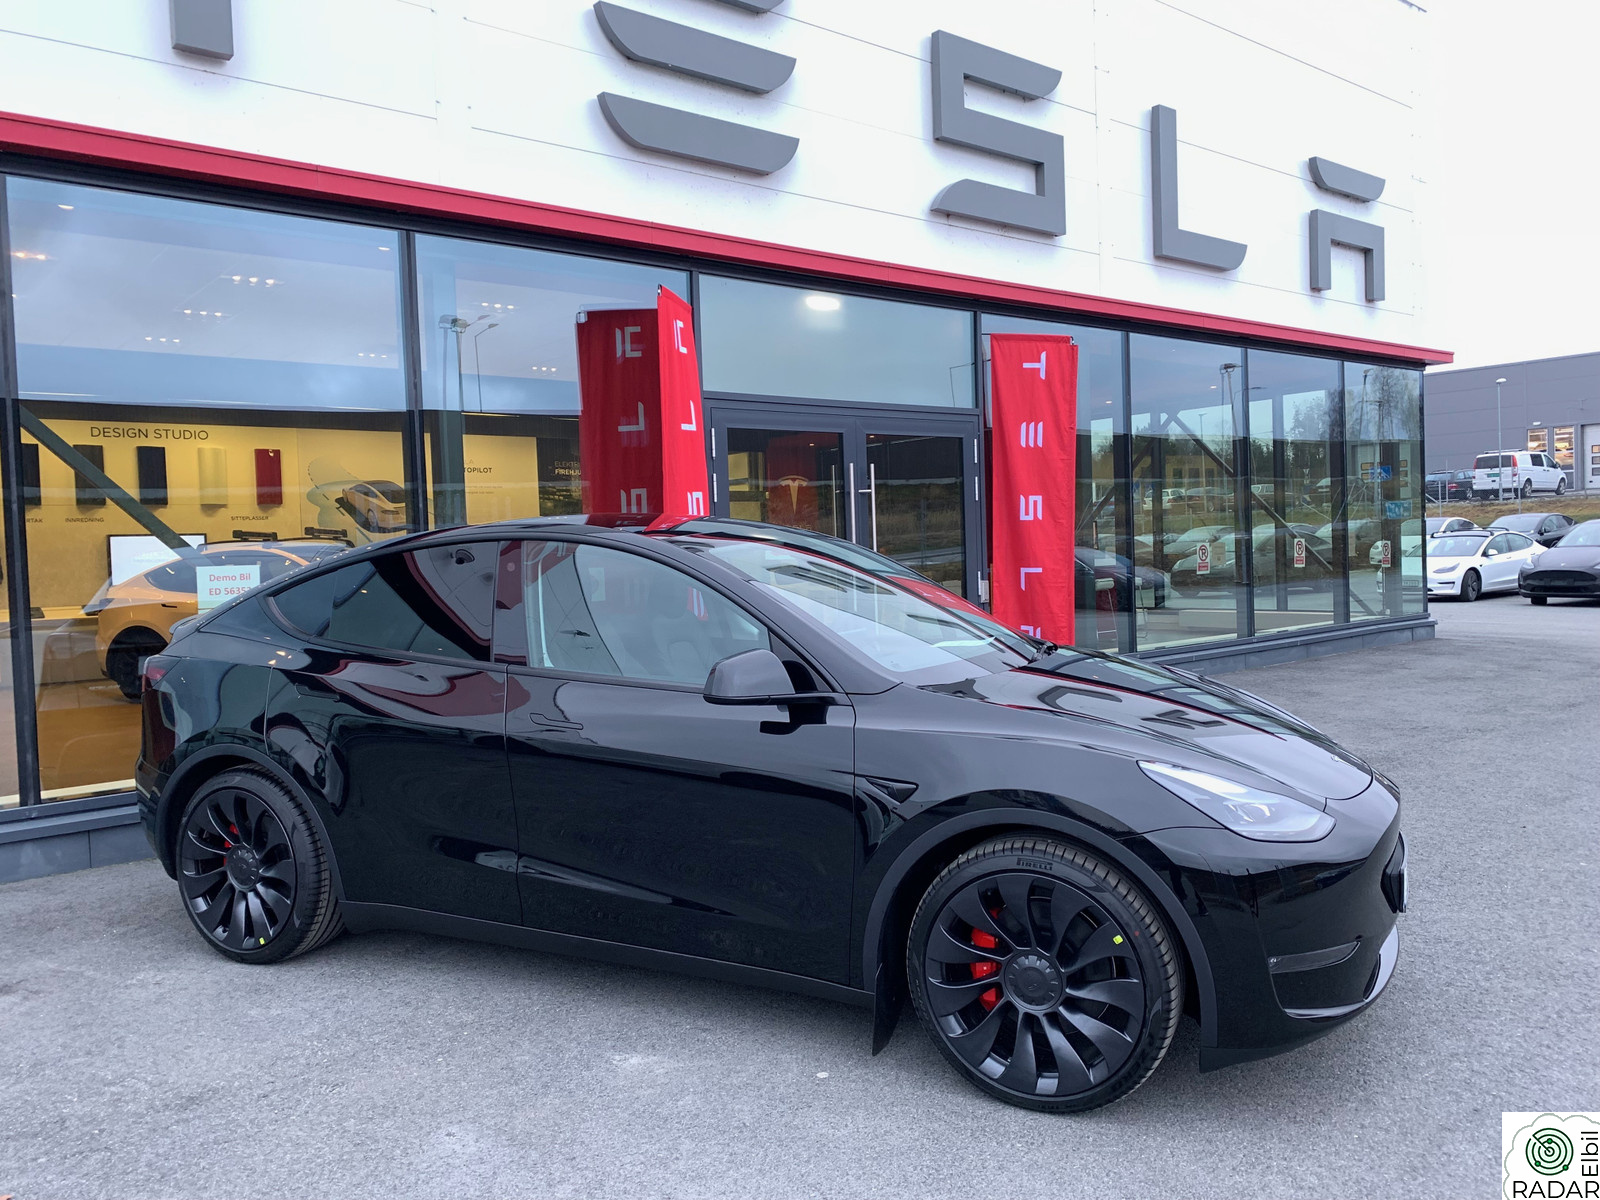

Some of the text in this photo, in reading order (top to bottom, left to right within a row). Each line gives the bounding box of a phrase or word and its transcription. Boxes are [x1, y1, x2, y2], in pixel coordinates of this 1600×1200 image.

[90, 426, 209, 441] DESIGN STUDIO
[208, 572, 251, 582] Demo Bil
[208, 587, 222, 596] ED
[1016, 857, 1053, 871] PIRELLI
